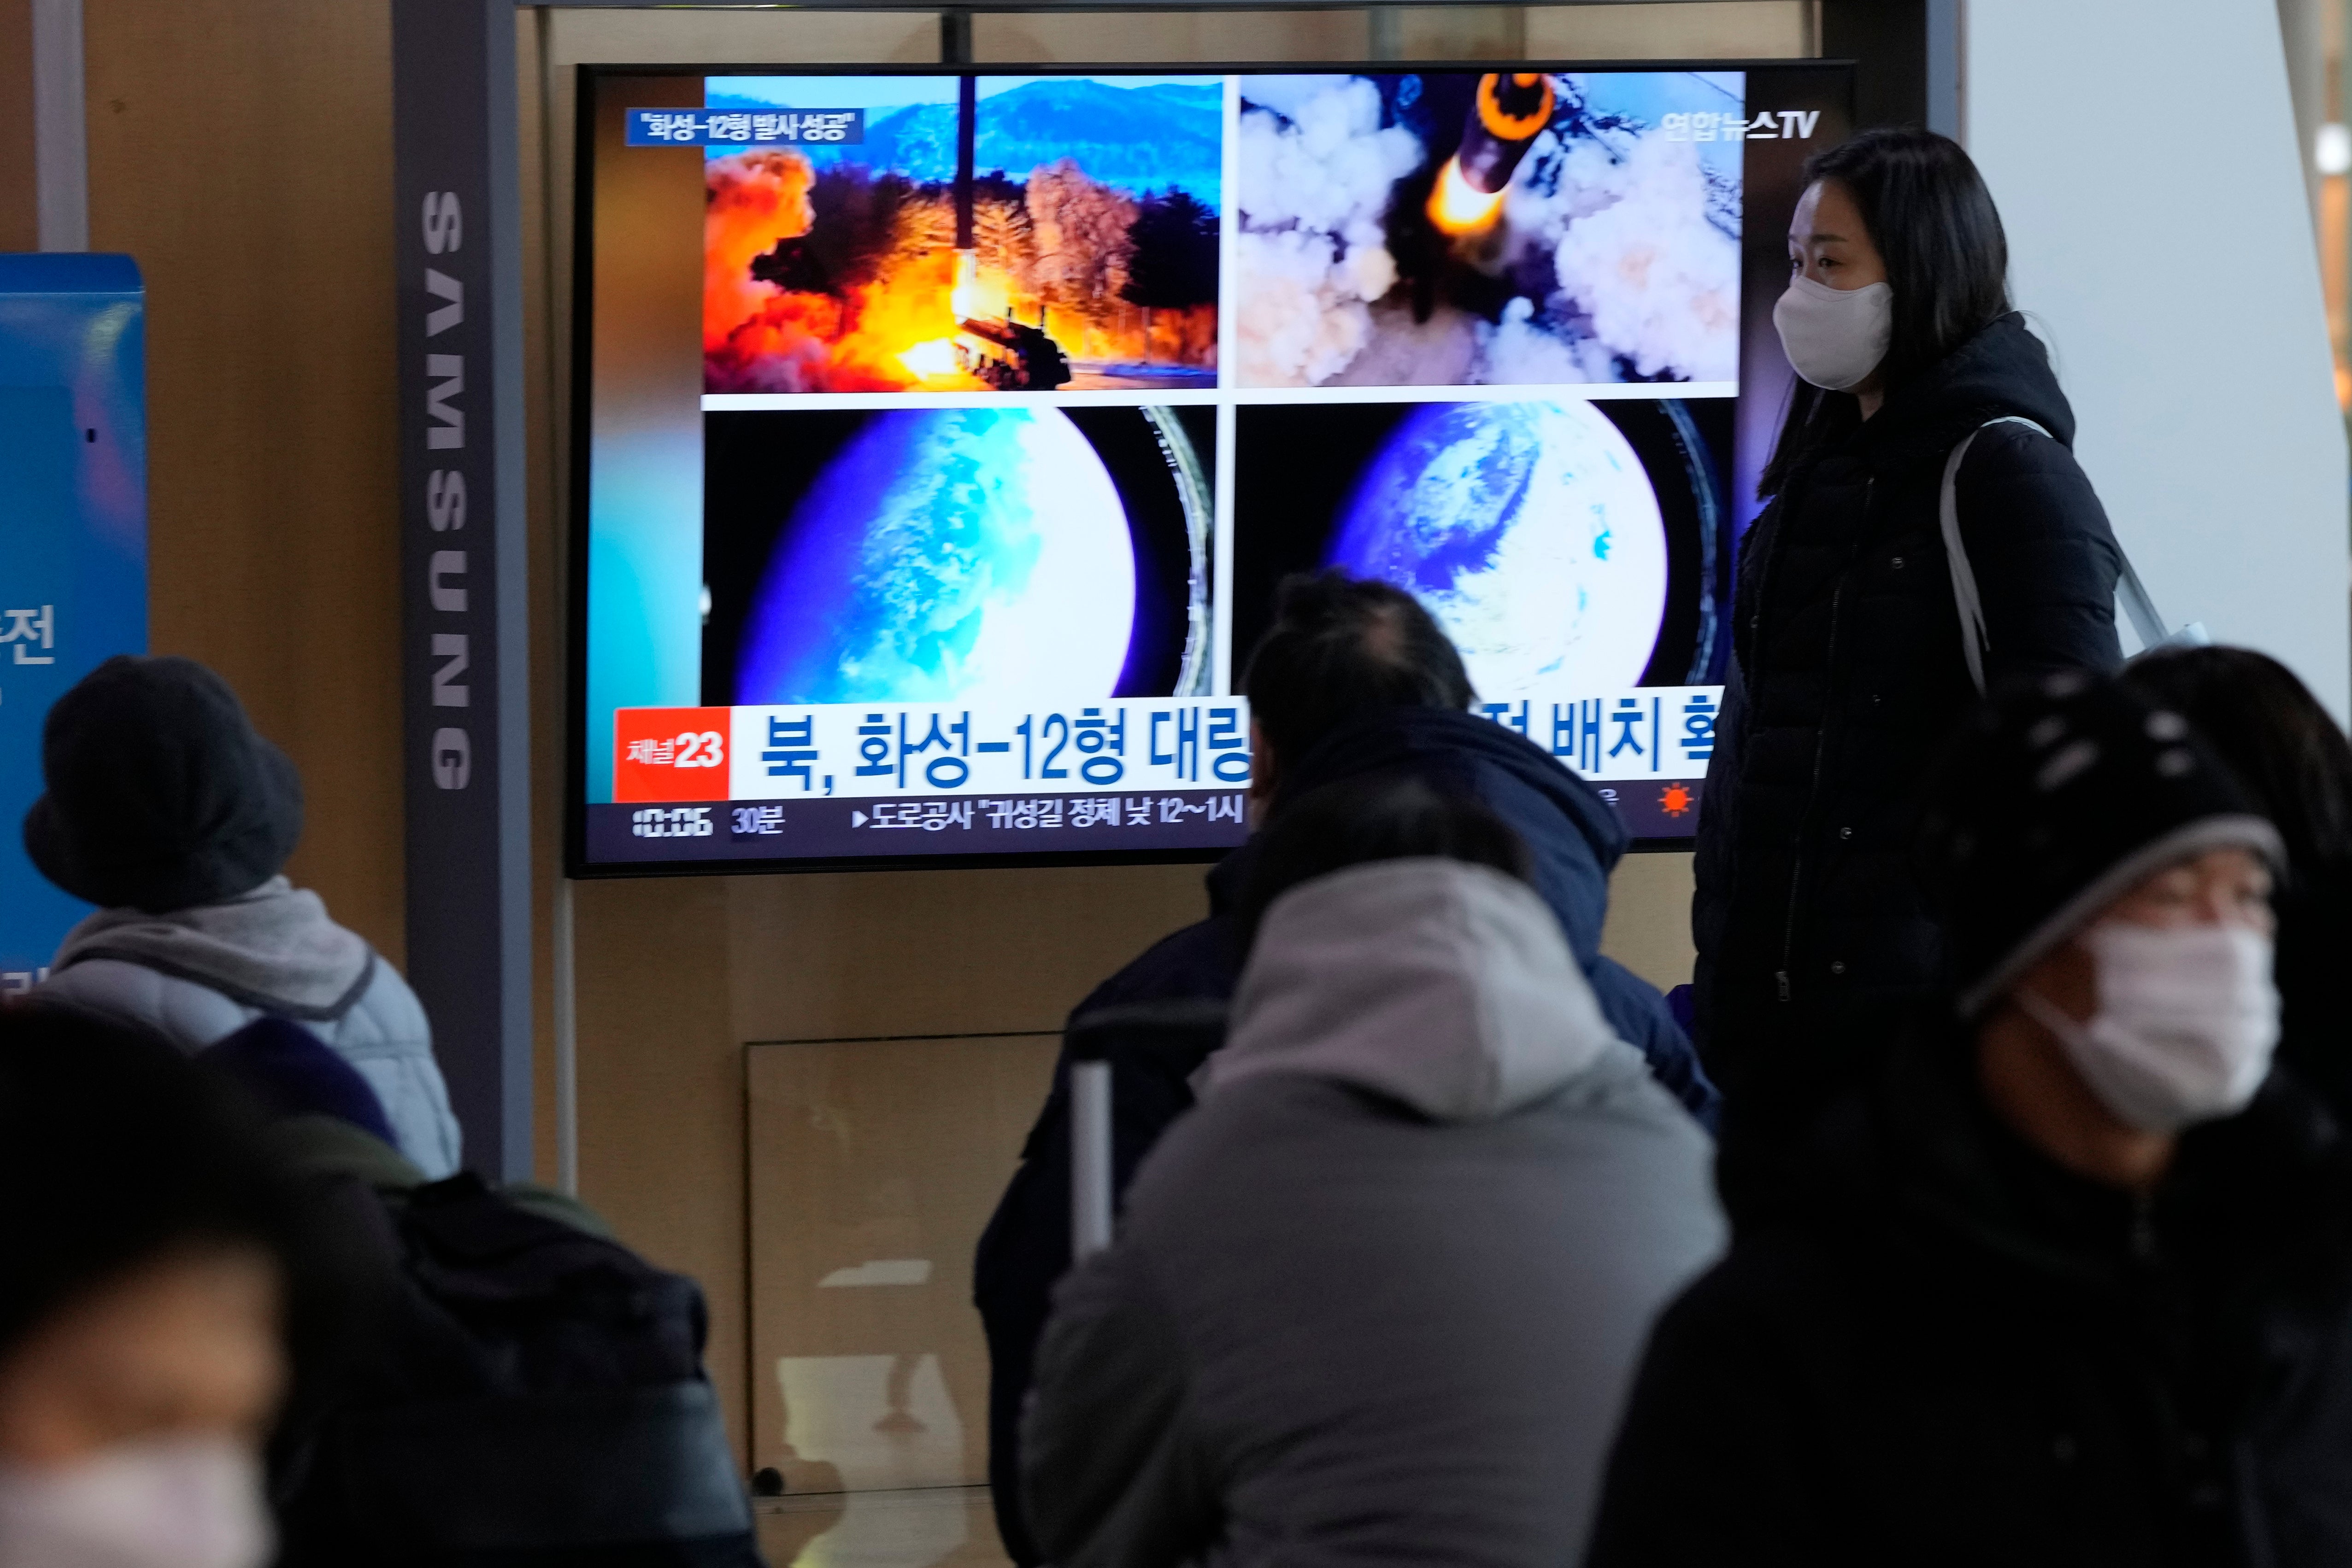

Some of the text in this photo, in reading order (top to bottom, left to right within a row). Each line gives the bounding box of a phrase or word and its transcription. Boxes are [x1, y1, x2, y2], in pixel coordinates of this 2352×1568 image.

[753, 113, 800, 141] 발사
[1661, 110, 1821, 142] 연합뉴스TV
[421, 190, 472, 791] SAMSUNG
[0, 605, 54, 664] 전
[761, 714, 835, 796] 북,
[853, 707, 1124, 789] 화성-12형
[1552, 696, 1660, 773] 배치
[731, 805, 785, 834] 30분
[870, 800, 976, 831] 도로공사
[977, 799, 1064, 829] "귀성길
[1067, 797, 1121, 828] 정체
[1125, 796, 1154, 826] 낮
